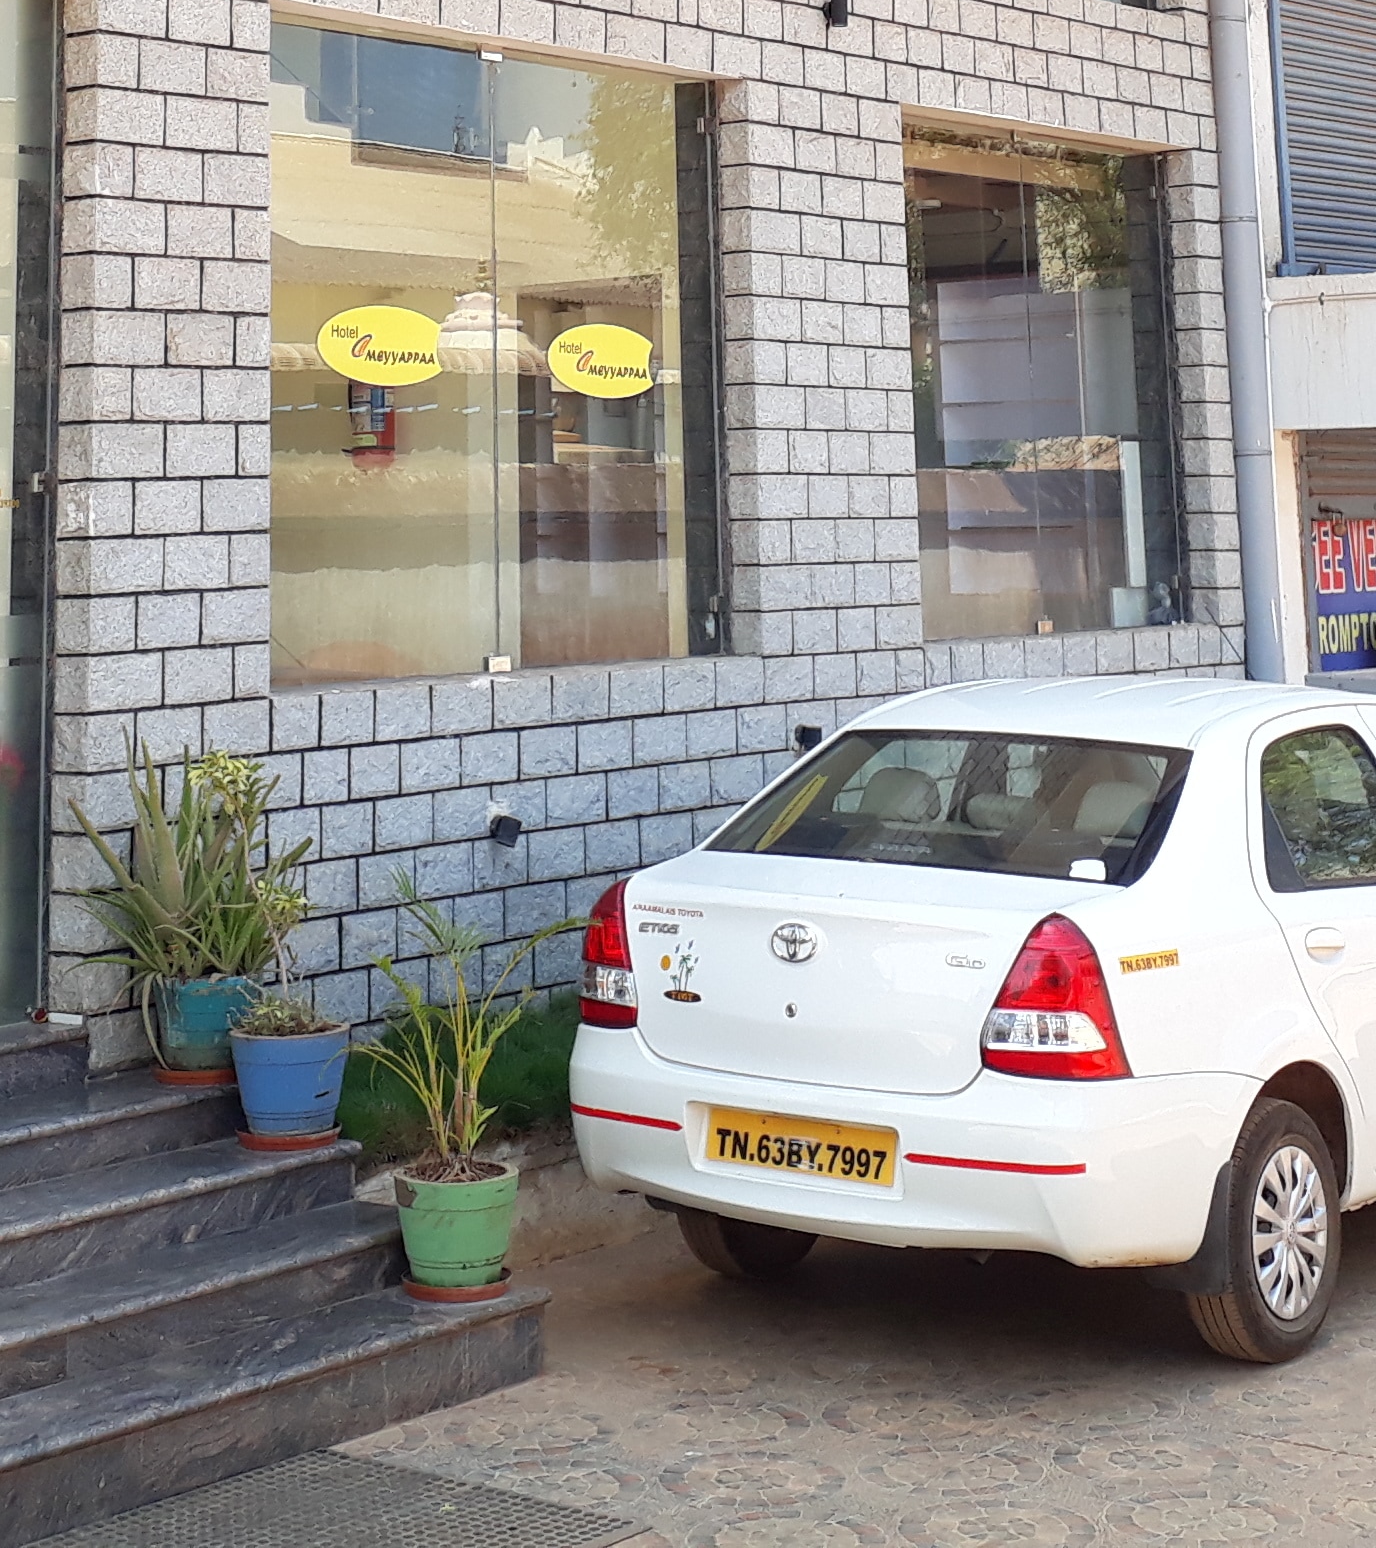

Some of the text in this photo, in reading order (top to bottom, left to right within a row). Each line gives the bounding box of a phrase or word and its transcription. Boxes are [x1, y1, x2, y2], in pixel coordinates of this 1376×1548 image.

[331, 324, 359, 339] Hotel
[559, 341, 582, 355] Hotel
[1312, 519, 1346, 594] EE
[677, 908, 704, 918] TOYOTA
[1119, 951, 1180, 973] TN.63BY.7997
[716, 1126, 888, 1181] TN.63BY.7997
